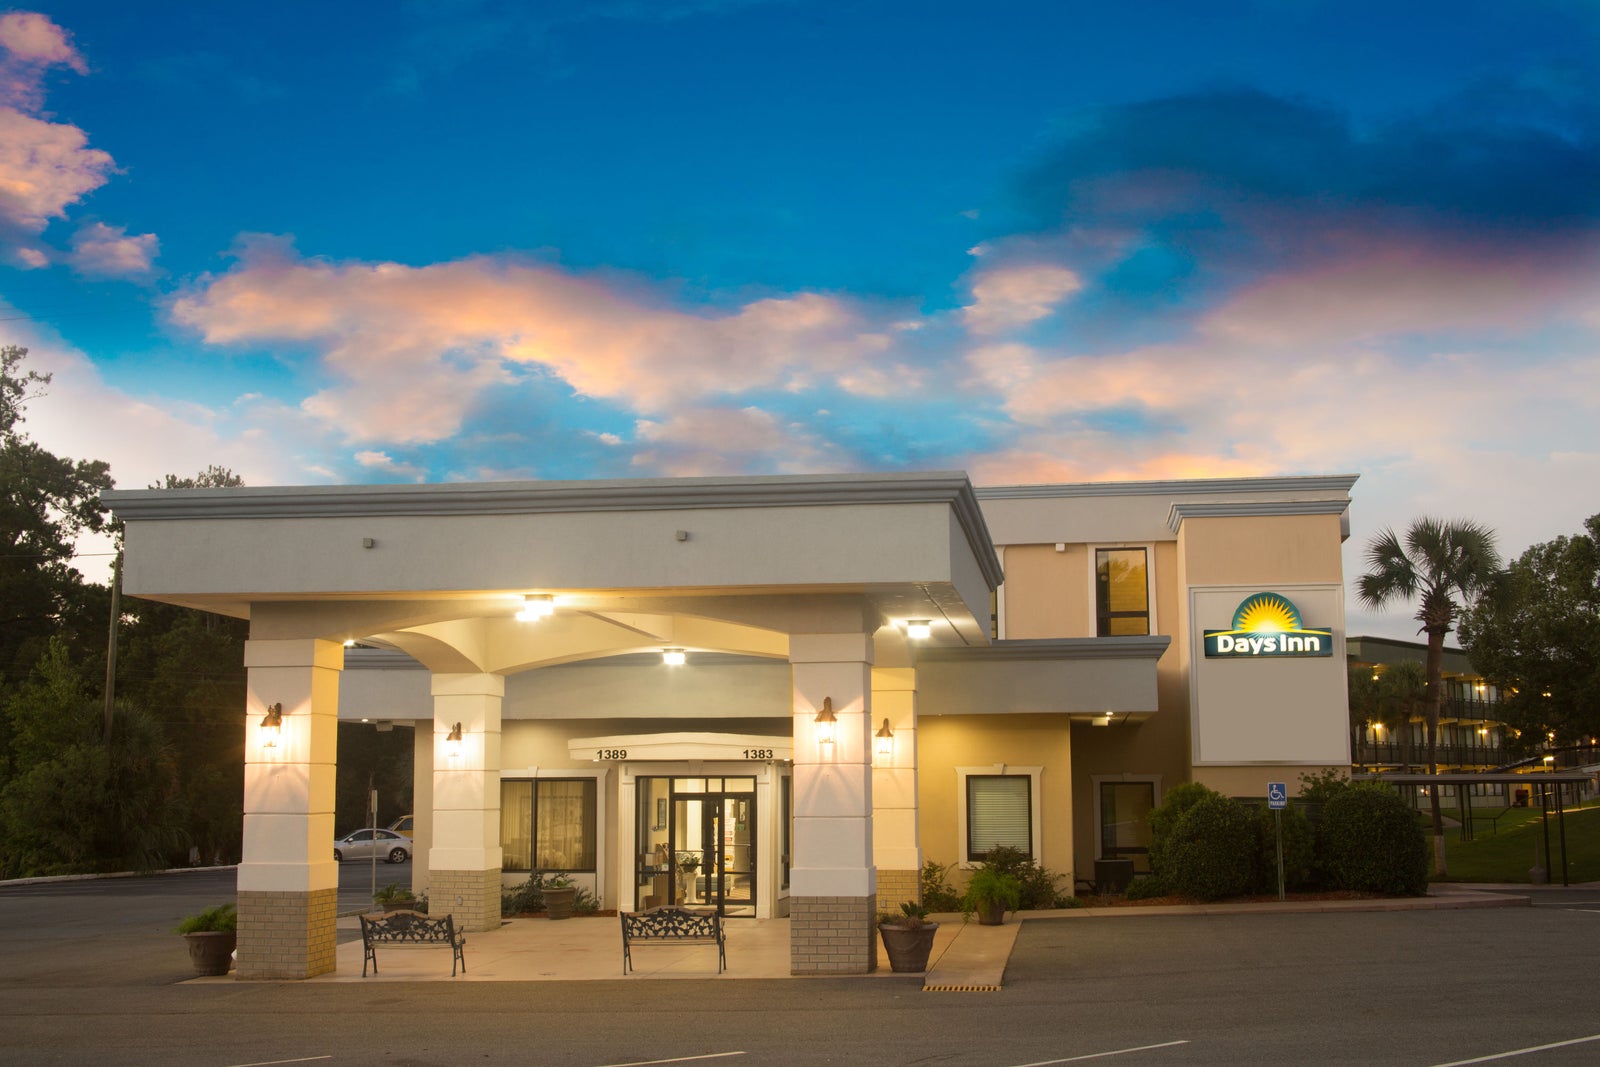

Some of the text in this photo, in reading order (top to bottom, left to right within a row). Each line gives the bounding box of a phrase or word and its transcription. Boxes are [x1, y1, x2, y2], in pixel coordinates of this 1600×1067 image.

[1217, 634, 1320, 655] Days Inn
[596, 749, 627, 760] 1389
[743, 749, 773, 759] 1383
